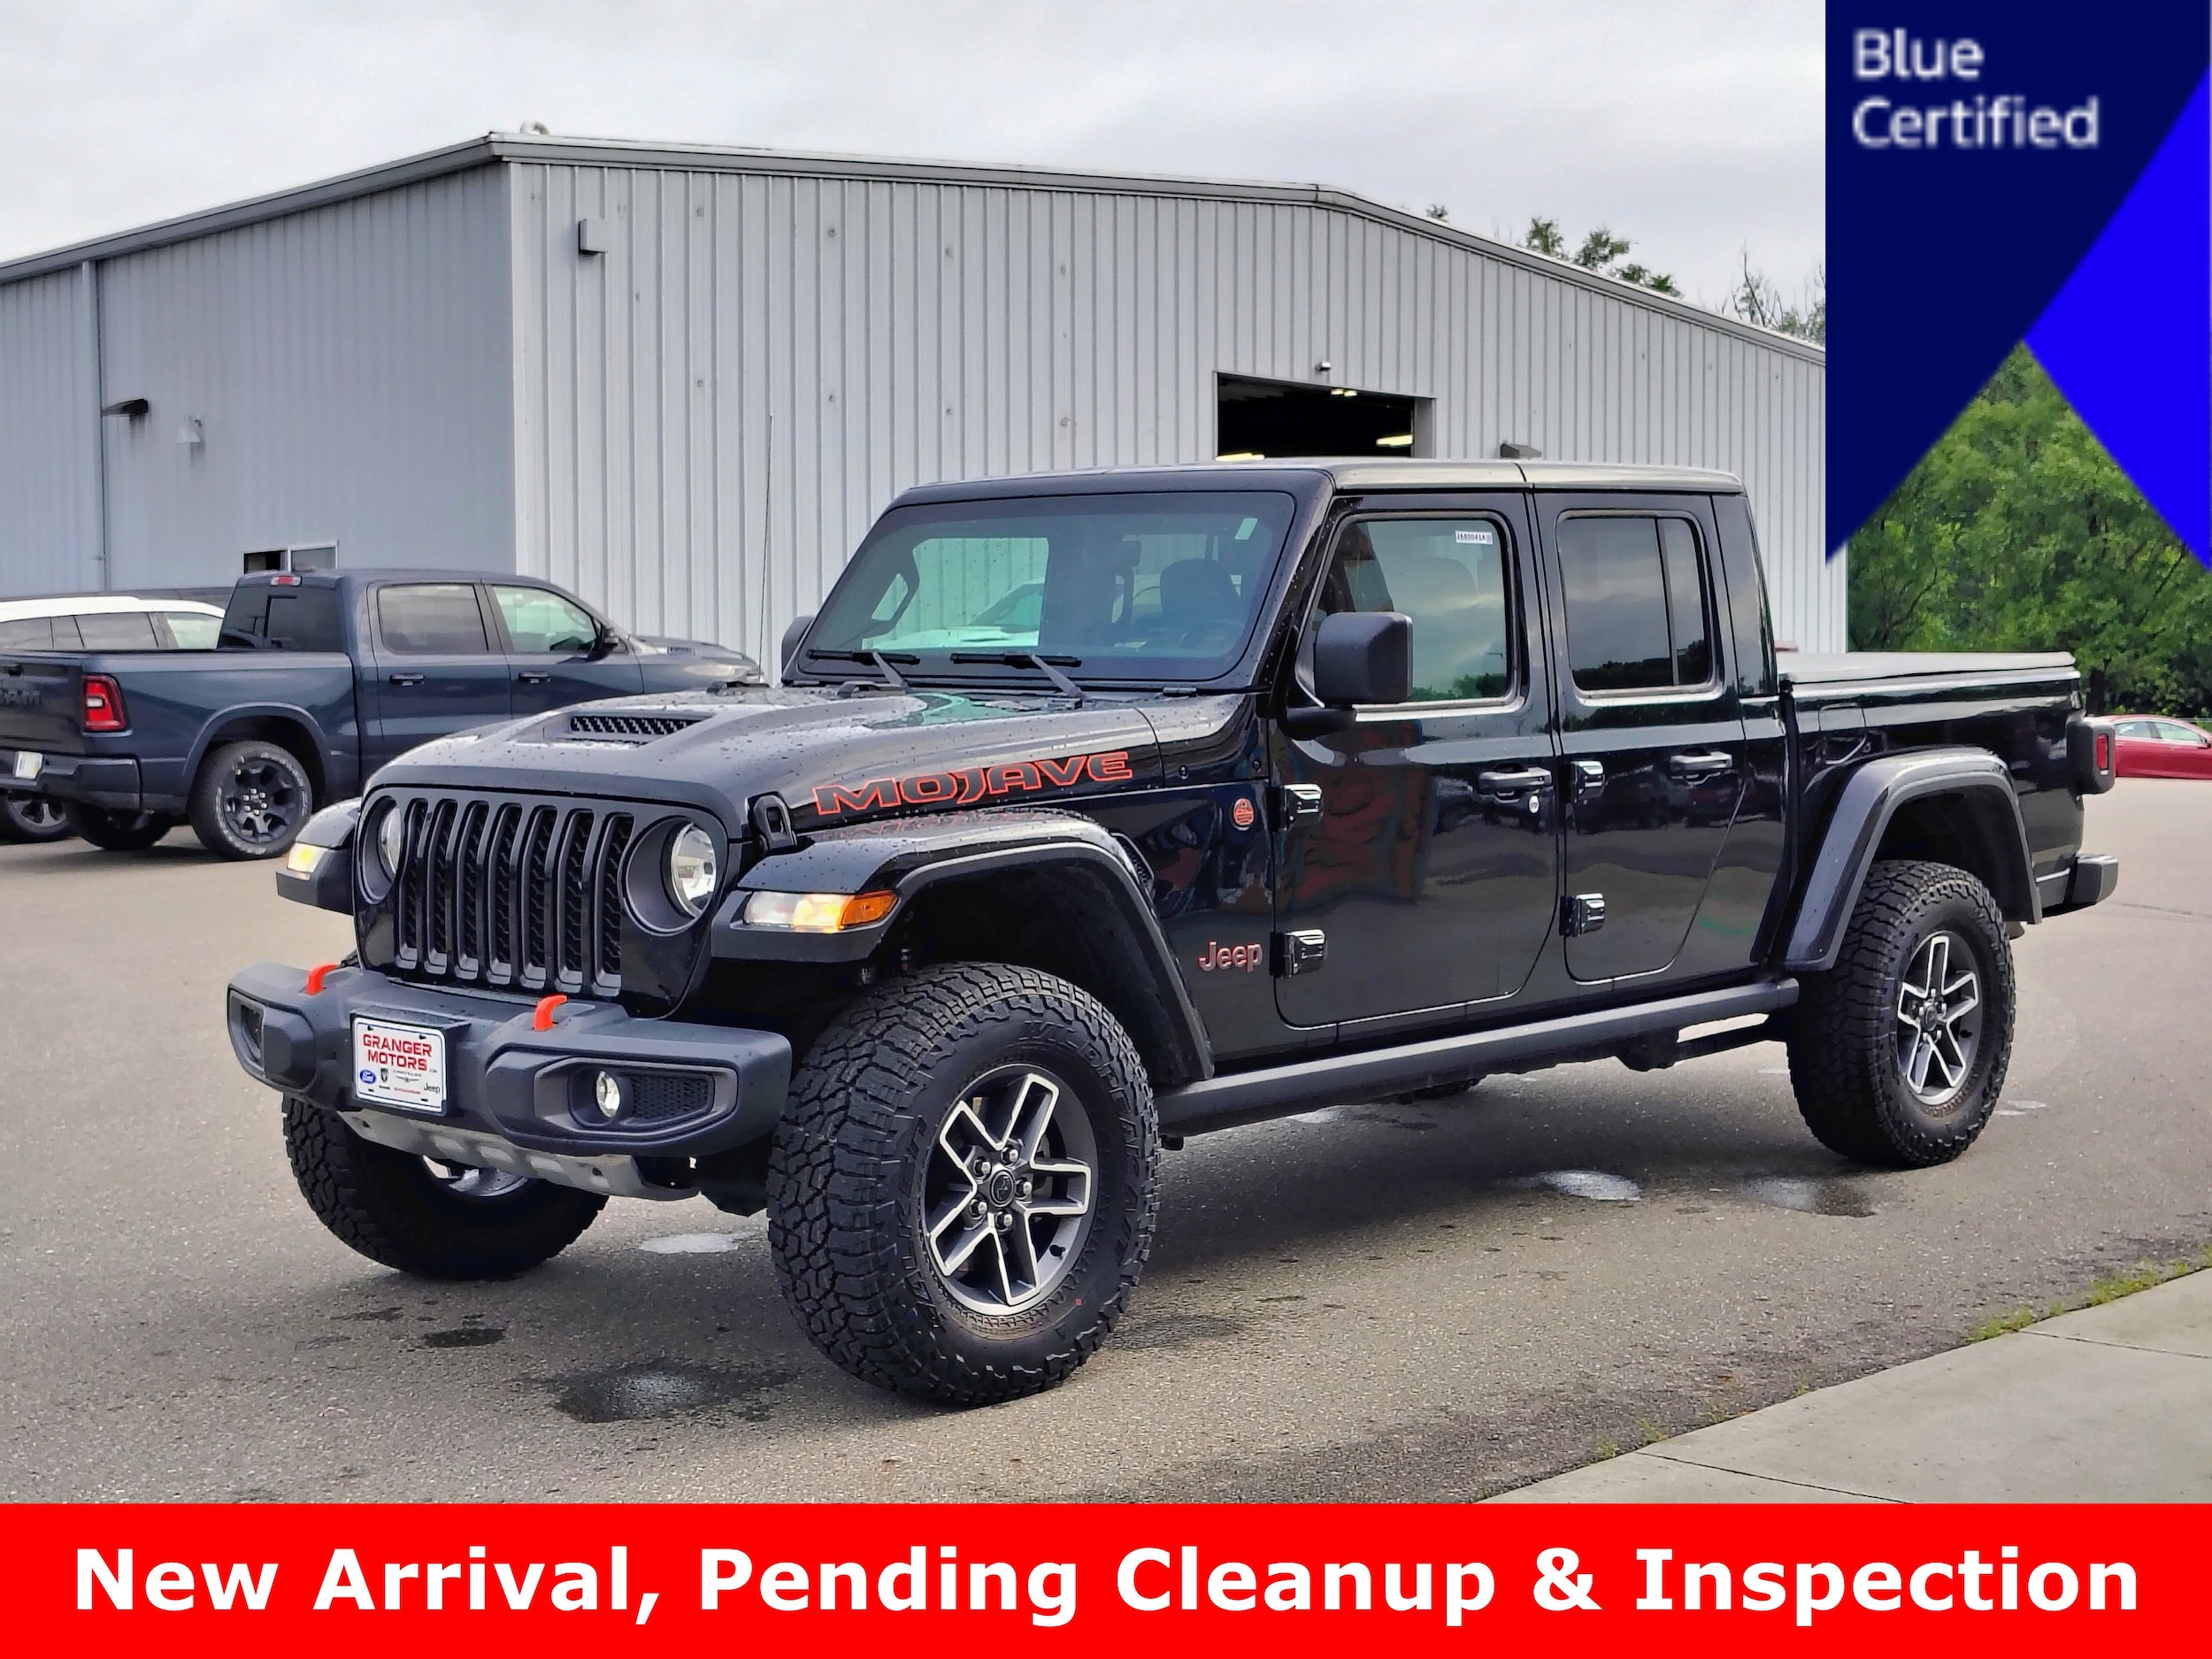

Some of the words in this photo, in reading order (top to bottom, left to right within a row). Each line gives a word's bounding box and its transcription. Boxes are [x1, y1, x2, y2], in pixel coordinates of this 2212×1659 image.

[811, 751, 1133, 815] MOJAVE
[1198, 941, 1263, 973] Jeep
[363, 1033, 432, 1057] GRANGER
[368, 1049, 427, 1071] MOTORS
